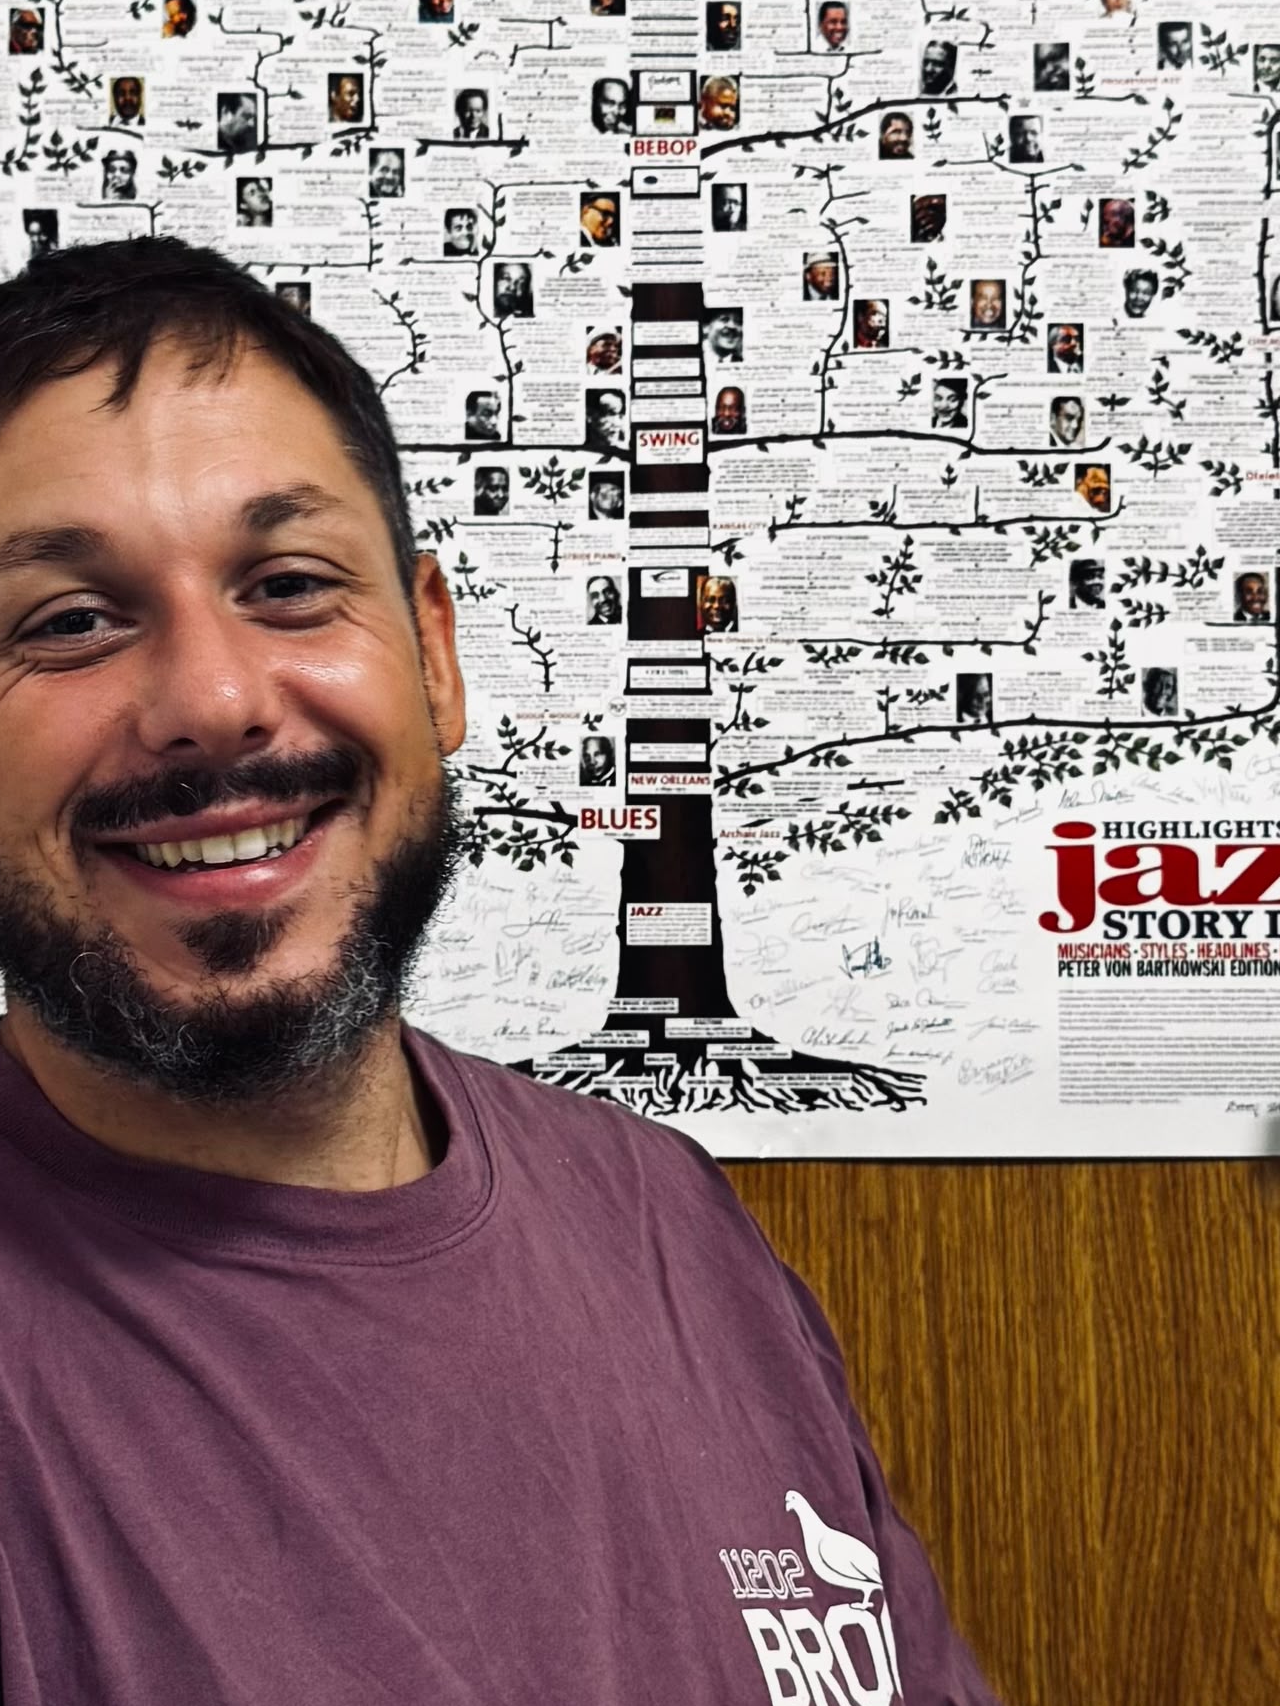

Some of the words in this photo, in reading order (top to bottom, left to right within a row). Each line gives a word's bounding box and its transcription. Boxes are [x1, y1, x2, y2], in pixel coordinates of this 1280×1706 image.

[634, 140, 697, 155] BEBOP
[638, 430, 699, 446] SWING
[631, 775, 657, 786] NEW
[660, 774, 710, 786] ORLEANS
[581, 808, 657, 829] BLUES
[630, 906, 663, 917] JAZZ
[1103, 910, 1253, 940] STORY
[1058, 943, 1131, 959] MUSICIANS
[1141, 943, 1187, 960] STYLES
[1198, 943, 1270, 959] HEADLINES
[1058, 960, 1100, 977] PETER
[1105, 960, 1131, 977] VON
[1137, 959, 1225, 977] BARTKOWSKI
[719, 1548, 813, 1599] 11202
